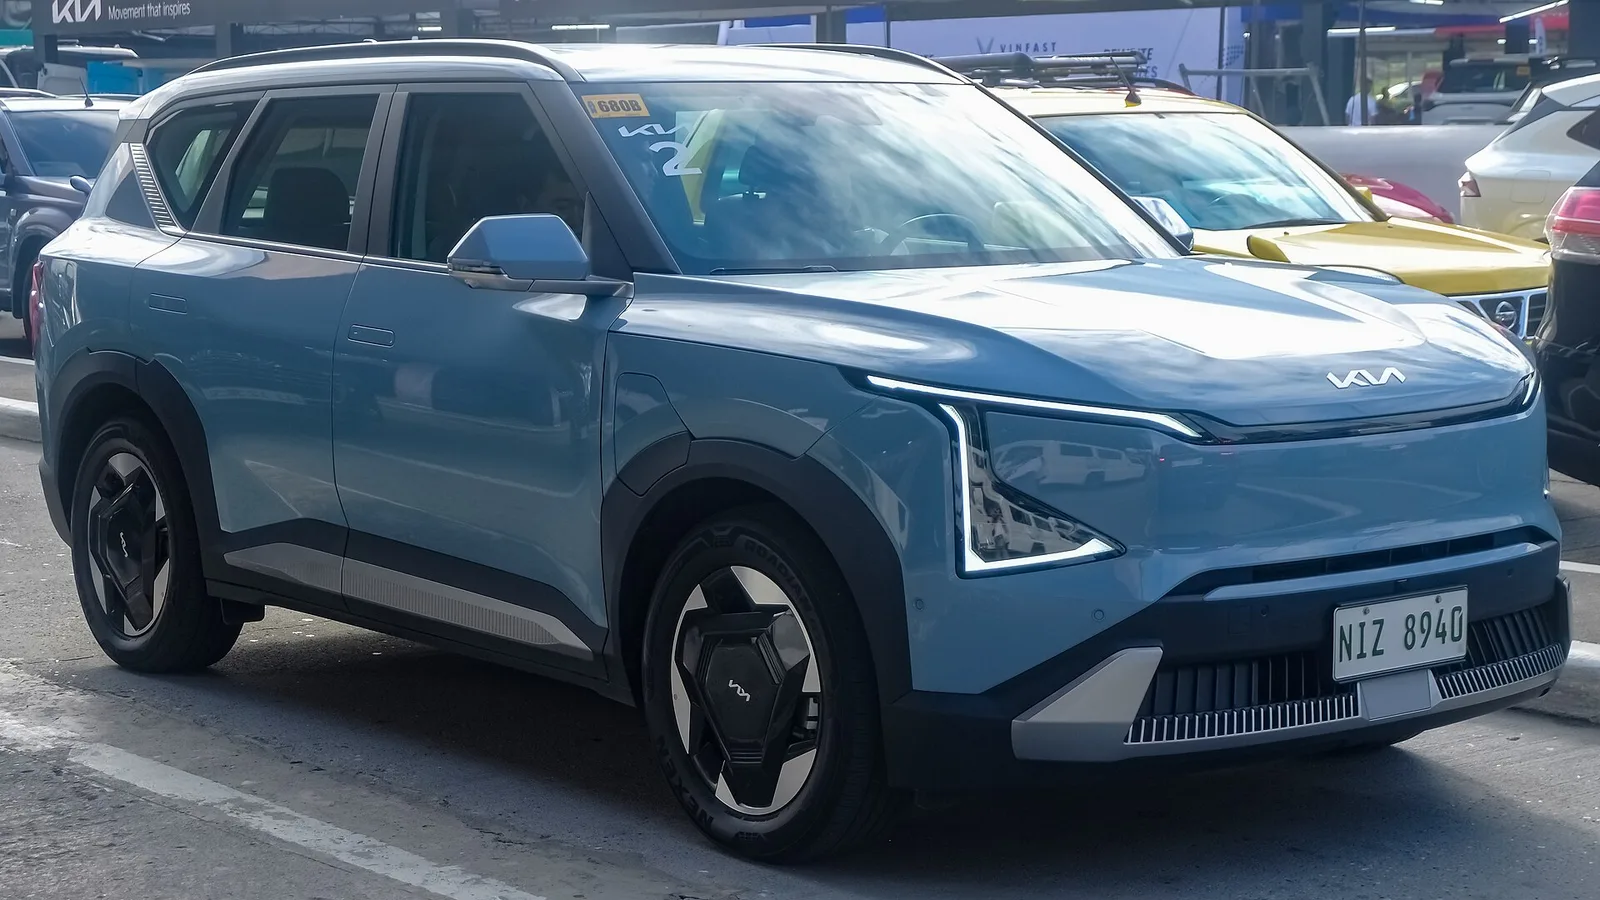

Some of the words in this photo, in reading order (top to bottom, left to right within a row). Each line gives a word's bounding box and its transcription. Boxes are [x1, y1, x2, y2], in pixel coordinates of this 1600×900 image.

[52, 0, 101, 23] KIA
[108, 5, 146, 20] Movement
[147, 4, 162, 17] that
[163, 2, 191, 19] inspires
[1000, 42, 1057, 53] VINFAST
[597, 100, 642, 112] 680B
[649, 141, 702, 176] 2
[1326, 367, 1406, 389] KIA
[1339, 619, 1385, 662] NIZ
[1404, 605, 1463, 650] 8940
[655, 735, 714, 830] NEXEN
